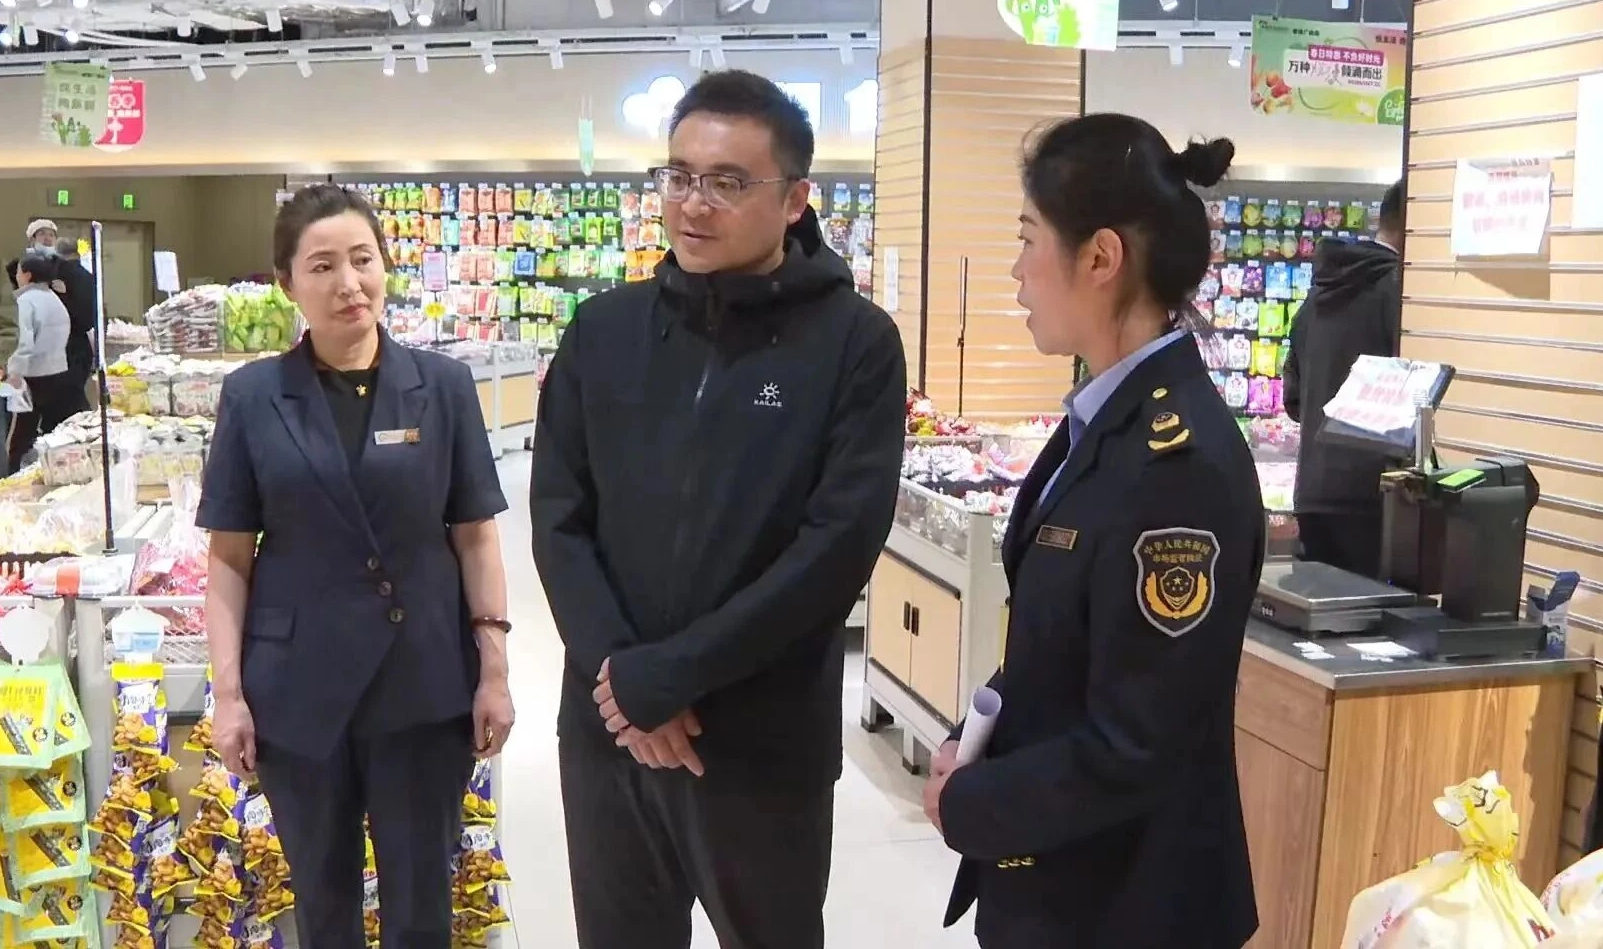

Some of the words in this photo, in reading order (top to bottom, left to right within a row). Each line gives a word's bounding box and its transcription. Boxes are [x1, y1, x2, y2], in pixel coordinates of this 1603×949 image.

[1143, 539, 1211, 555] 中华人民共和国
